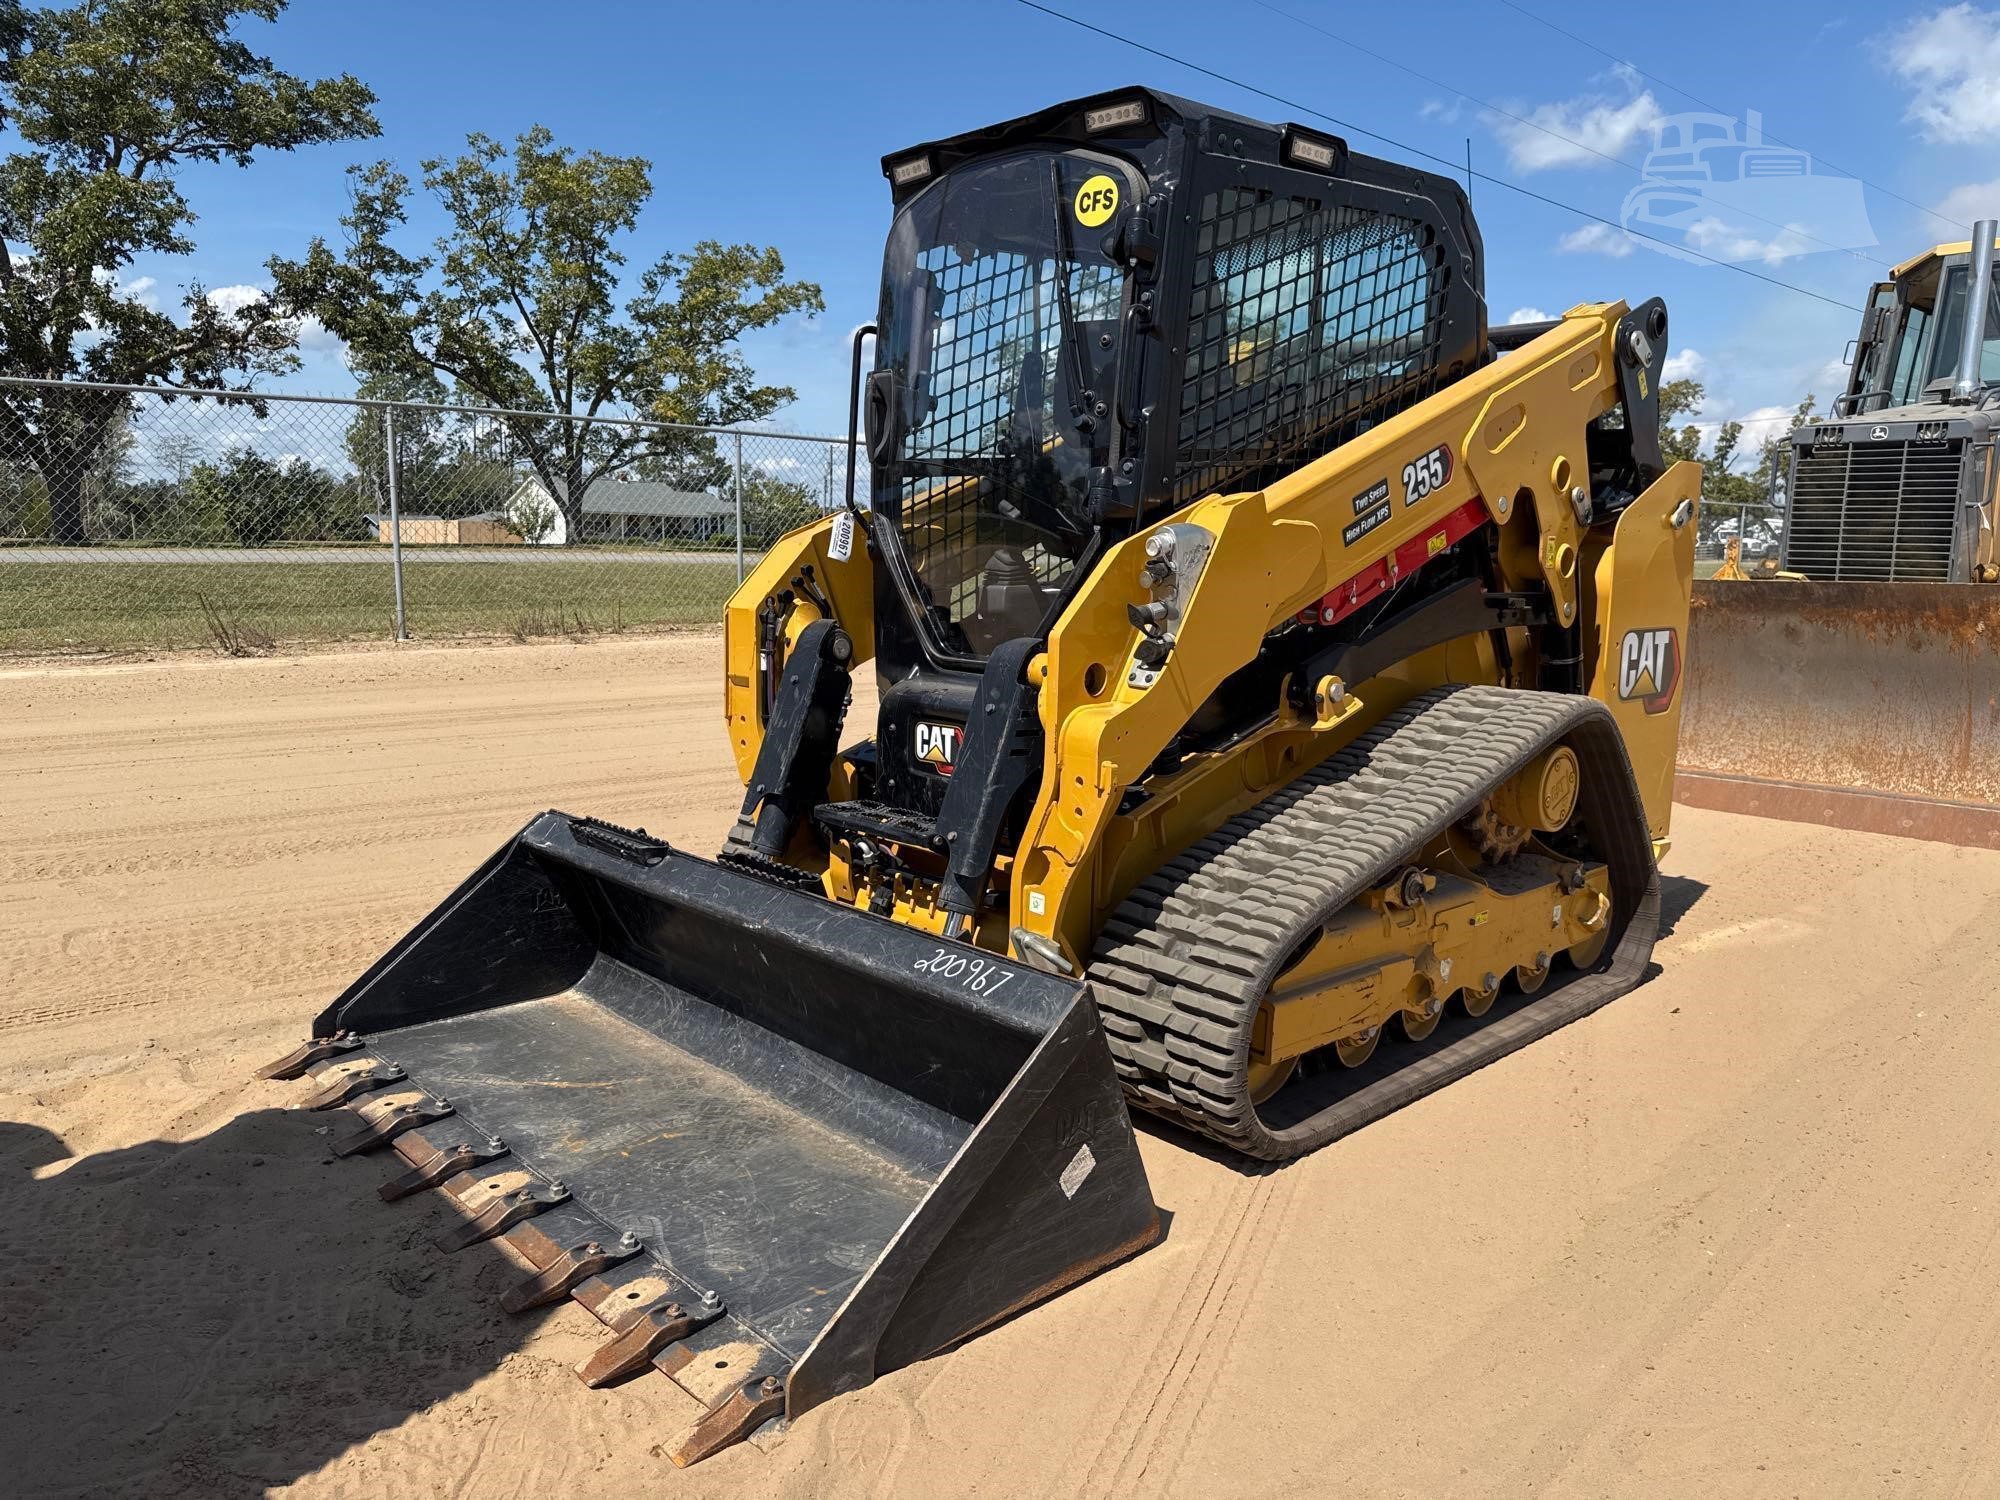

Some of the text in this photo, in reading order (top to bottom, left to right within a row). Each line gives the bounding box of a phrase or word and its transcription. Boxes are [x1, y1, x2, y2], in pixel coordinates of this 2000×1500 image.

[1078, 187, 1115, 214] CFS
[1402, 448, 1444, 506] 255
[1376, 505, 1389, 522] XPS
[837, 521, 852, 557] 200967
[1619, 630, 1671, 698] CAT
[916, 723, 955, 763] CAT
[914, 948, 1015, 997] 200967
